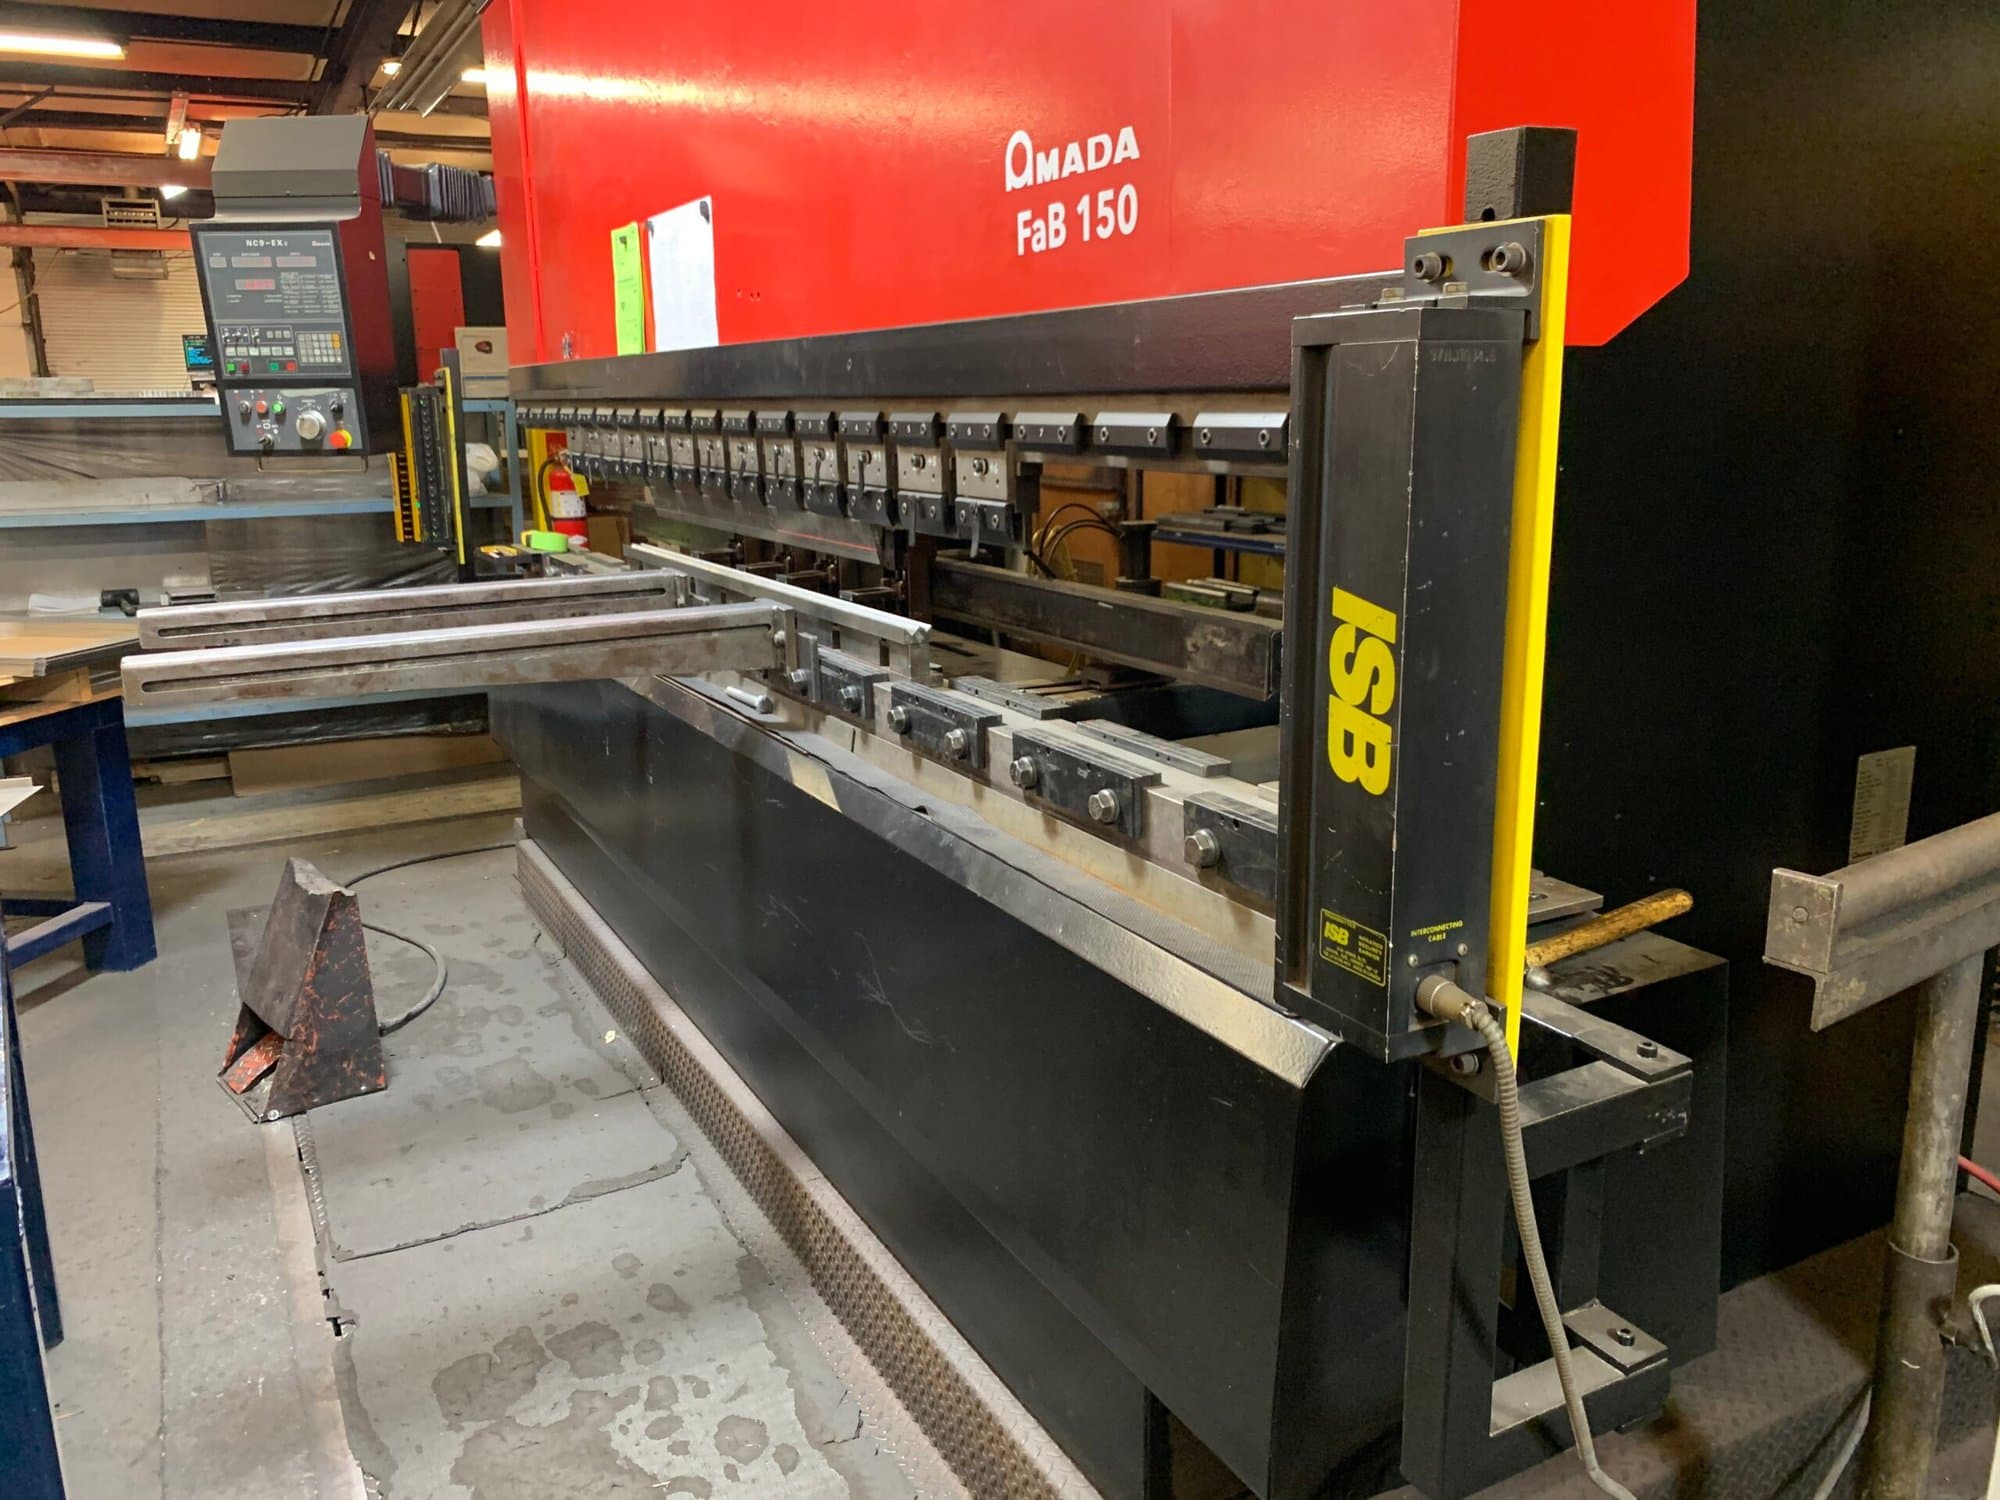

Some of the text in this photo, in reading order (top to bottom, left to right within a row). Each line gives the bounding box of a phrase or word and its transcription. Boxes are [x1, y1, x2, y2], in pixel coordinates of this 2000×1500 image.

[1005, 125, 1140, 192] AMADA
[1017, 183, 1138, 256] FaB 150
[1328, 587, 1397, 796] ISB
[1324, 921, 1349, 945] ISB
[1410, 920, 1464, 937] INTERCONNECTING
[1427, 932, 1447, 943] CABLE
